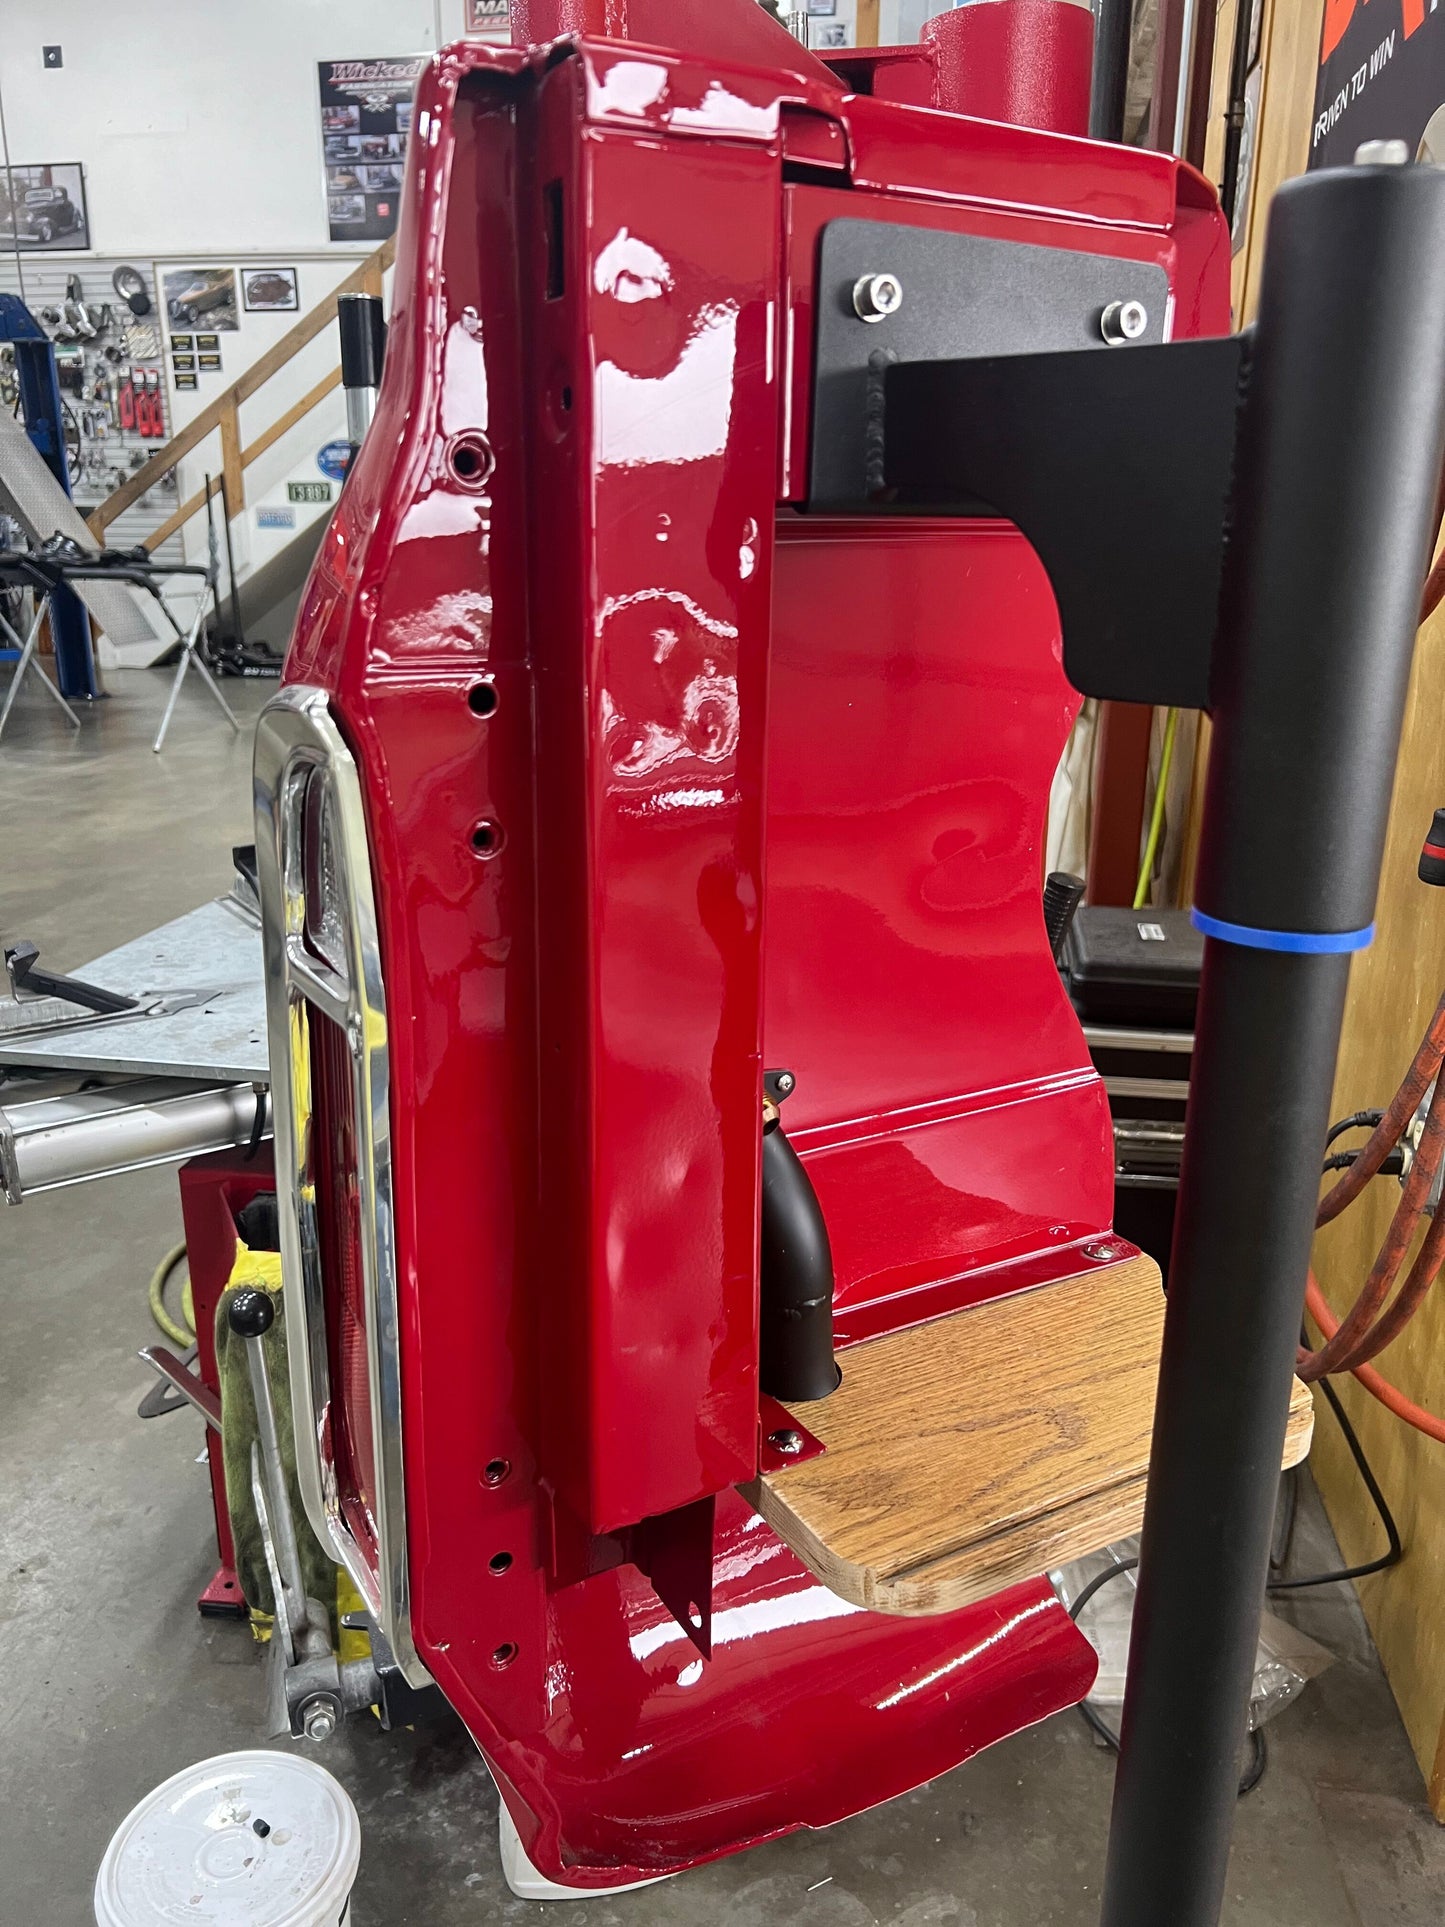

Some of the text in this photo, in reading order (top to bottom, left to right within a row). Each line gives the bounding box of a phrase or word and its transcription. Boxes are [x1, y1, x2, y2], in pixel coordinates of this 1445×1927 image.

[474, 0, 509, 15] MA
[1351, 62, 1367, 100] TO
[1370, 29, 1395, 79] WIN
